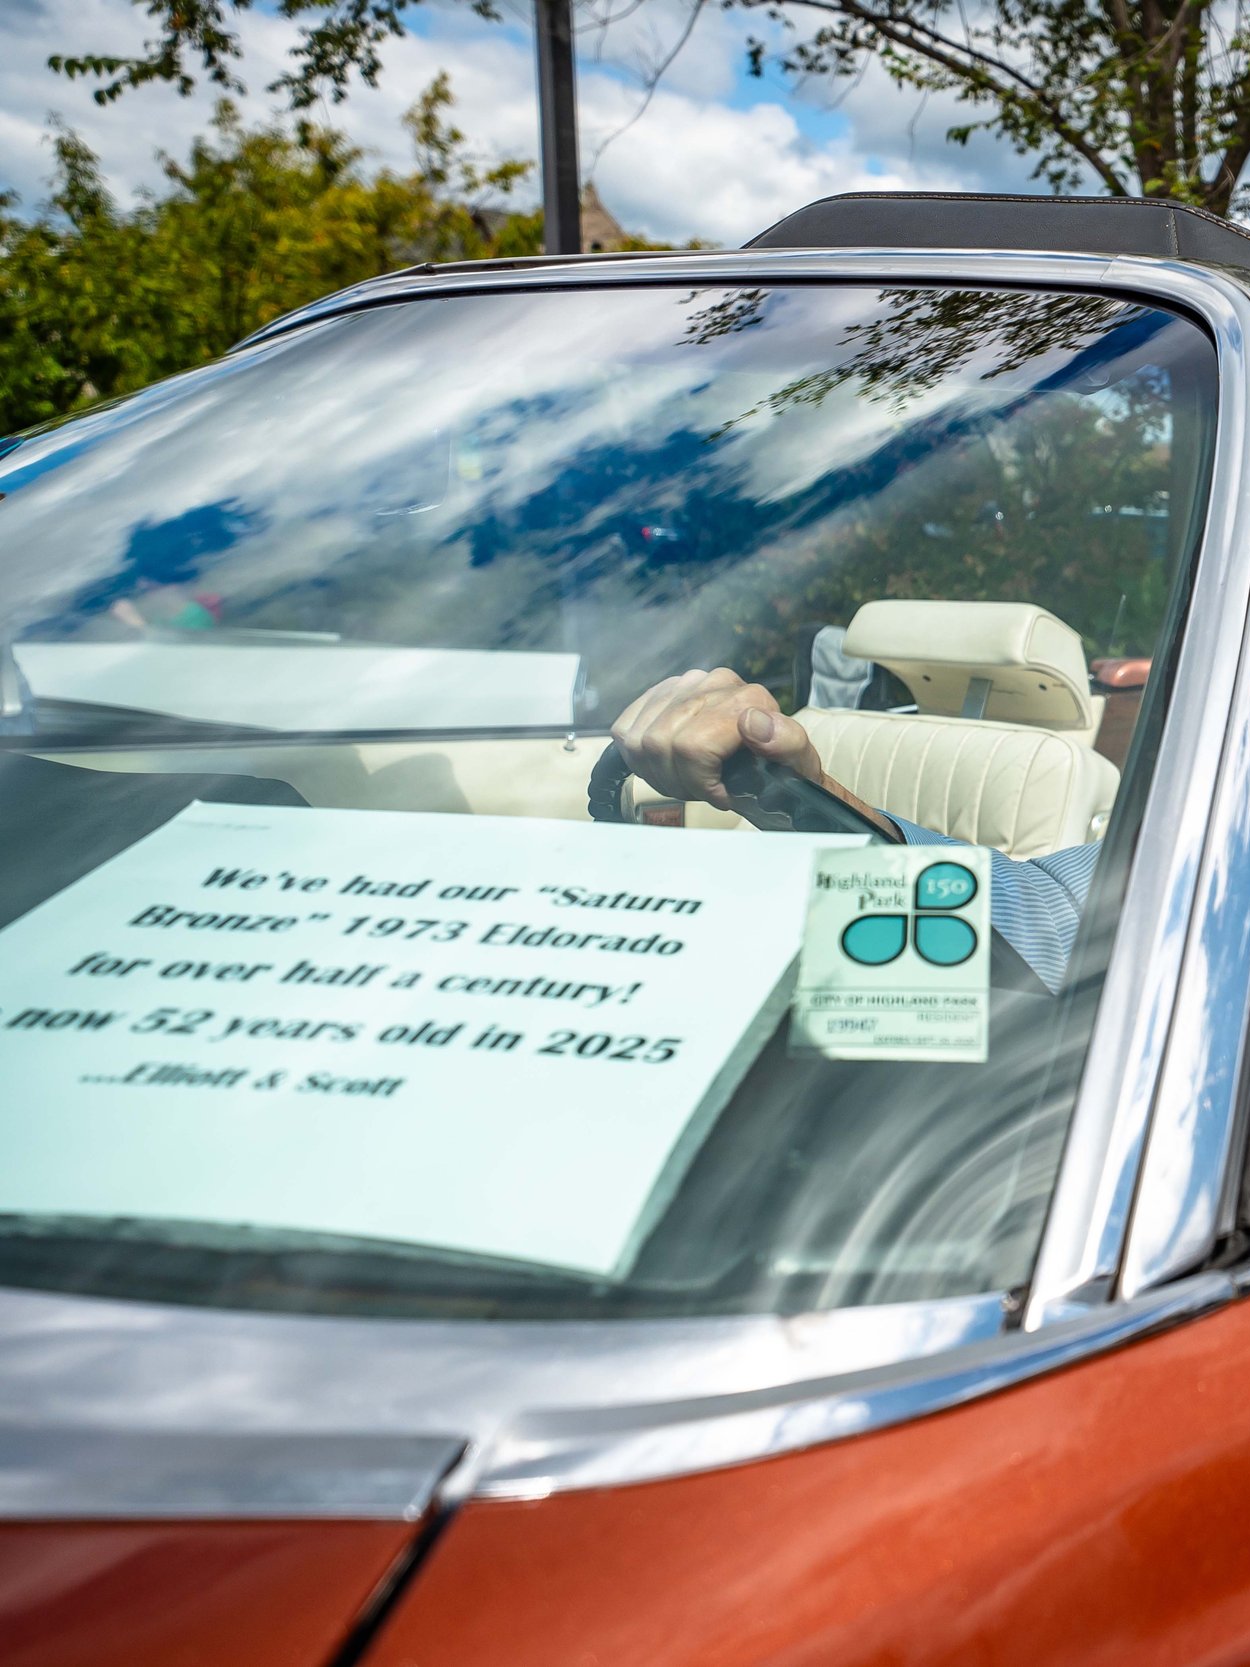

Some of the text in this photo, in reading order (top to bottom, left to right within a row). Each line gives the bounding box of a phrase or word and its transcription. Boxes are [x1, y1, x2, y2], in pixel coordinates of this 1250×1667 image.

[201, 867, 703, 915] We've had our “Saturn
[816, 872, 906, 892] Highland
[858, 888, 906, 910] Park
[925, 878, 969, 899] 150
[127, 904, 685, 956] Bronze” 1973 Eldorado
[66, 951, 644, 1009] for over half a century!
[3, 1007, 684, 1064] now 52 years old in 2025
[252, 1069, 290, 1091] &
[293, 1071, 407, 1098] Scott
